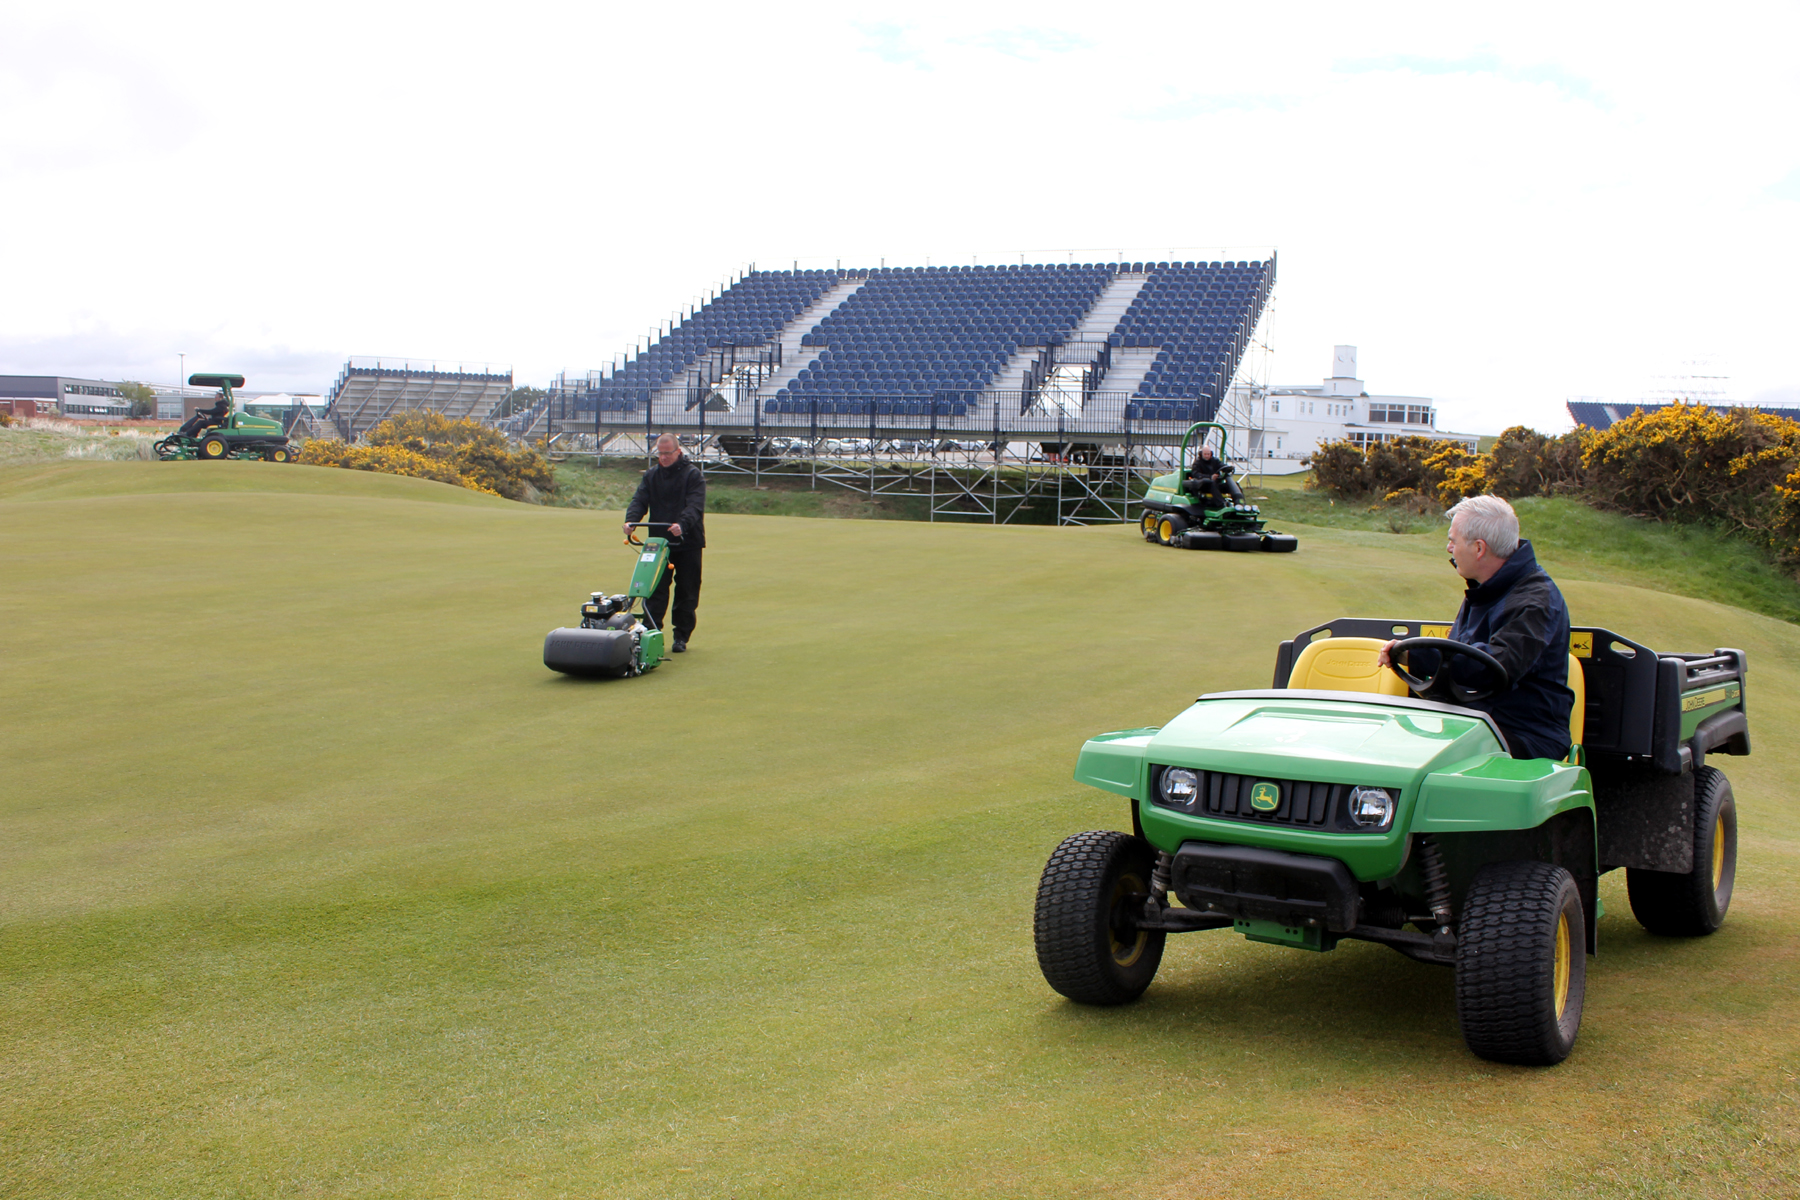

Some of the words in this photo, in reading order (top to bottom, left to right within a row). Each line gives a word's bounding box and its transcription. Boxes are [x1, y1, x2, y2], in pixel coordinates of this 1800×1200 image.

[549, 640, 573, 648] JOHN
[574, 641, 604, 650] DEERE
[1326, 658, 1347, 667] JOHN
[1347, 660, 1372, 668] DEERE
